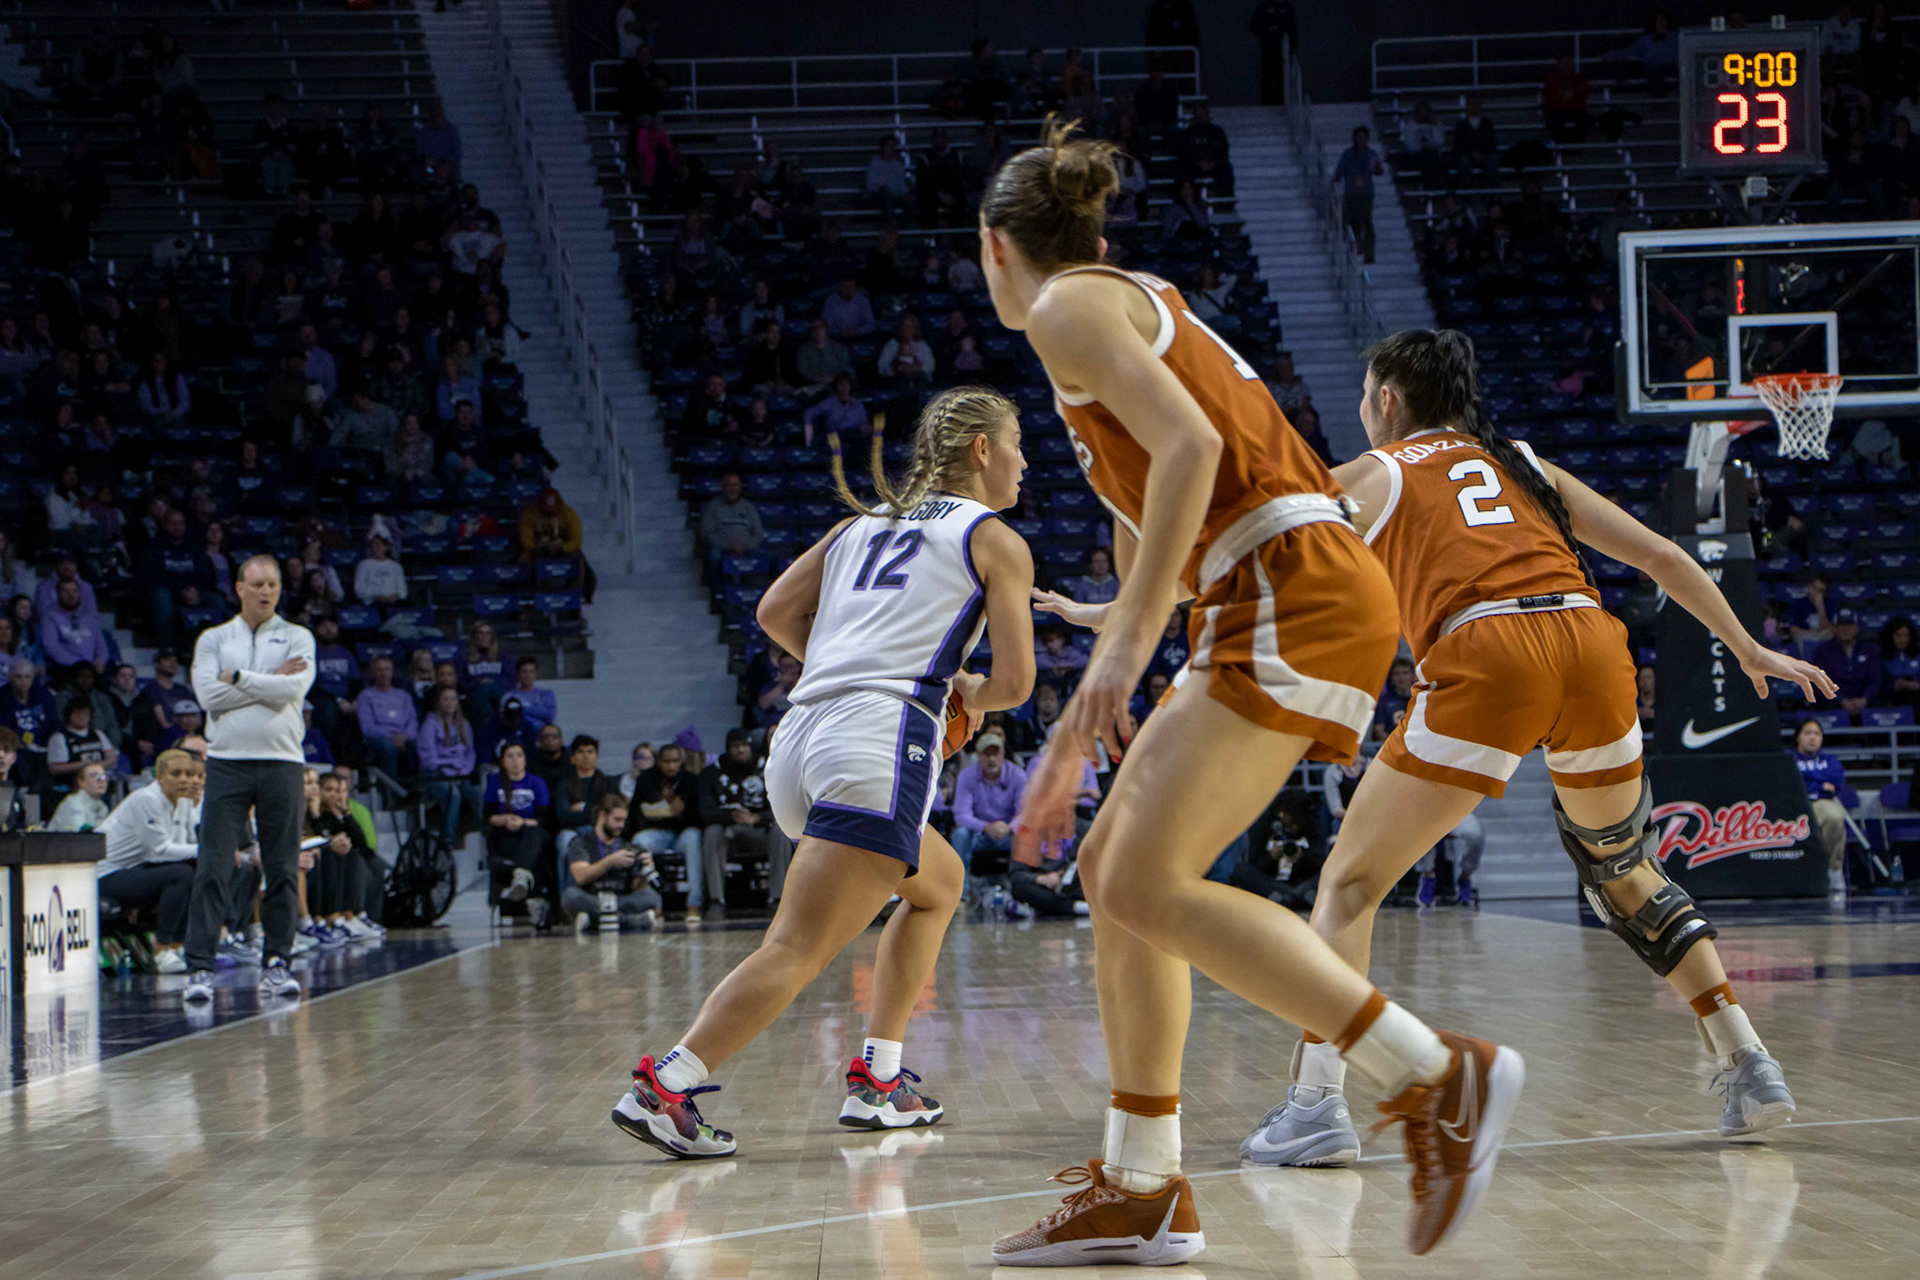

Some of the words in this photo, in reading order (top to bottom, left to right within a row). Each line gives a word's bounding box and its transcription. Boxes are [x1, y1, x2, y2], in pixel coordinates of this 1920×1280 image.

[1723, 52, 1797, 87] 9:00
[1713, 92, 1788, 154] 23
[892, 500, 963, 521] GORY
[1447, 458, 1517, 528] 2
[852, 528, 927, 591] 12
[1706, 567, 1726, 712] WCATS
[1651, 800, 1811, 864] Dillons
[23, 912, 46, 957] ACO
[67, 908, 89, 951] BELL
